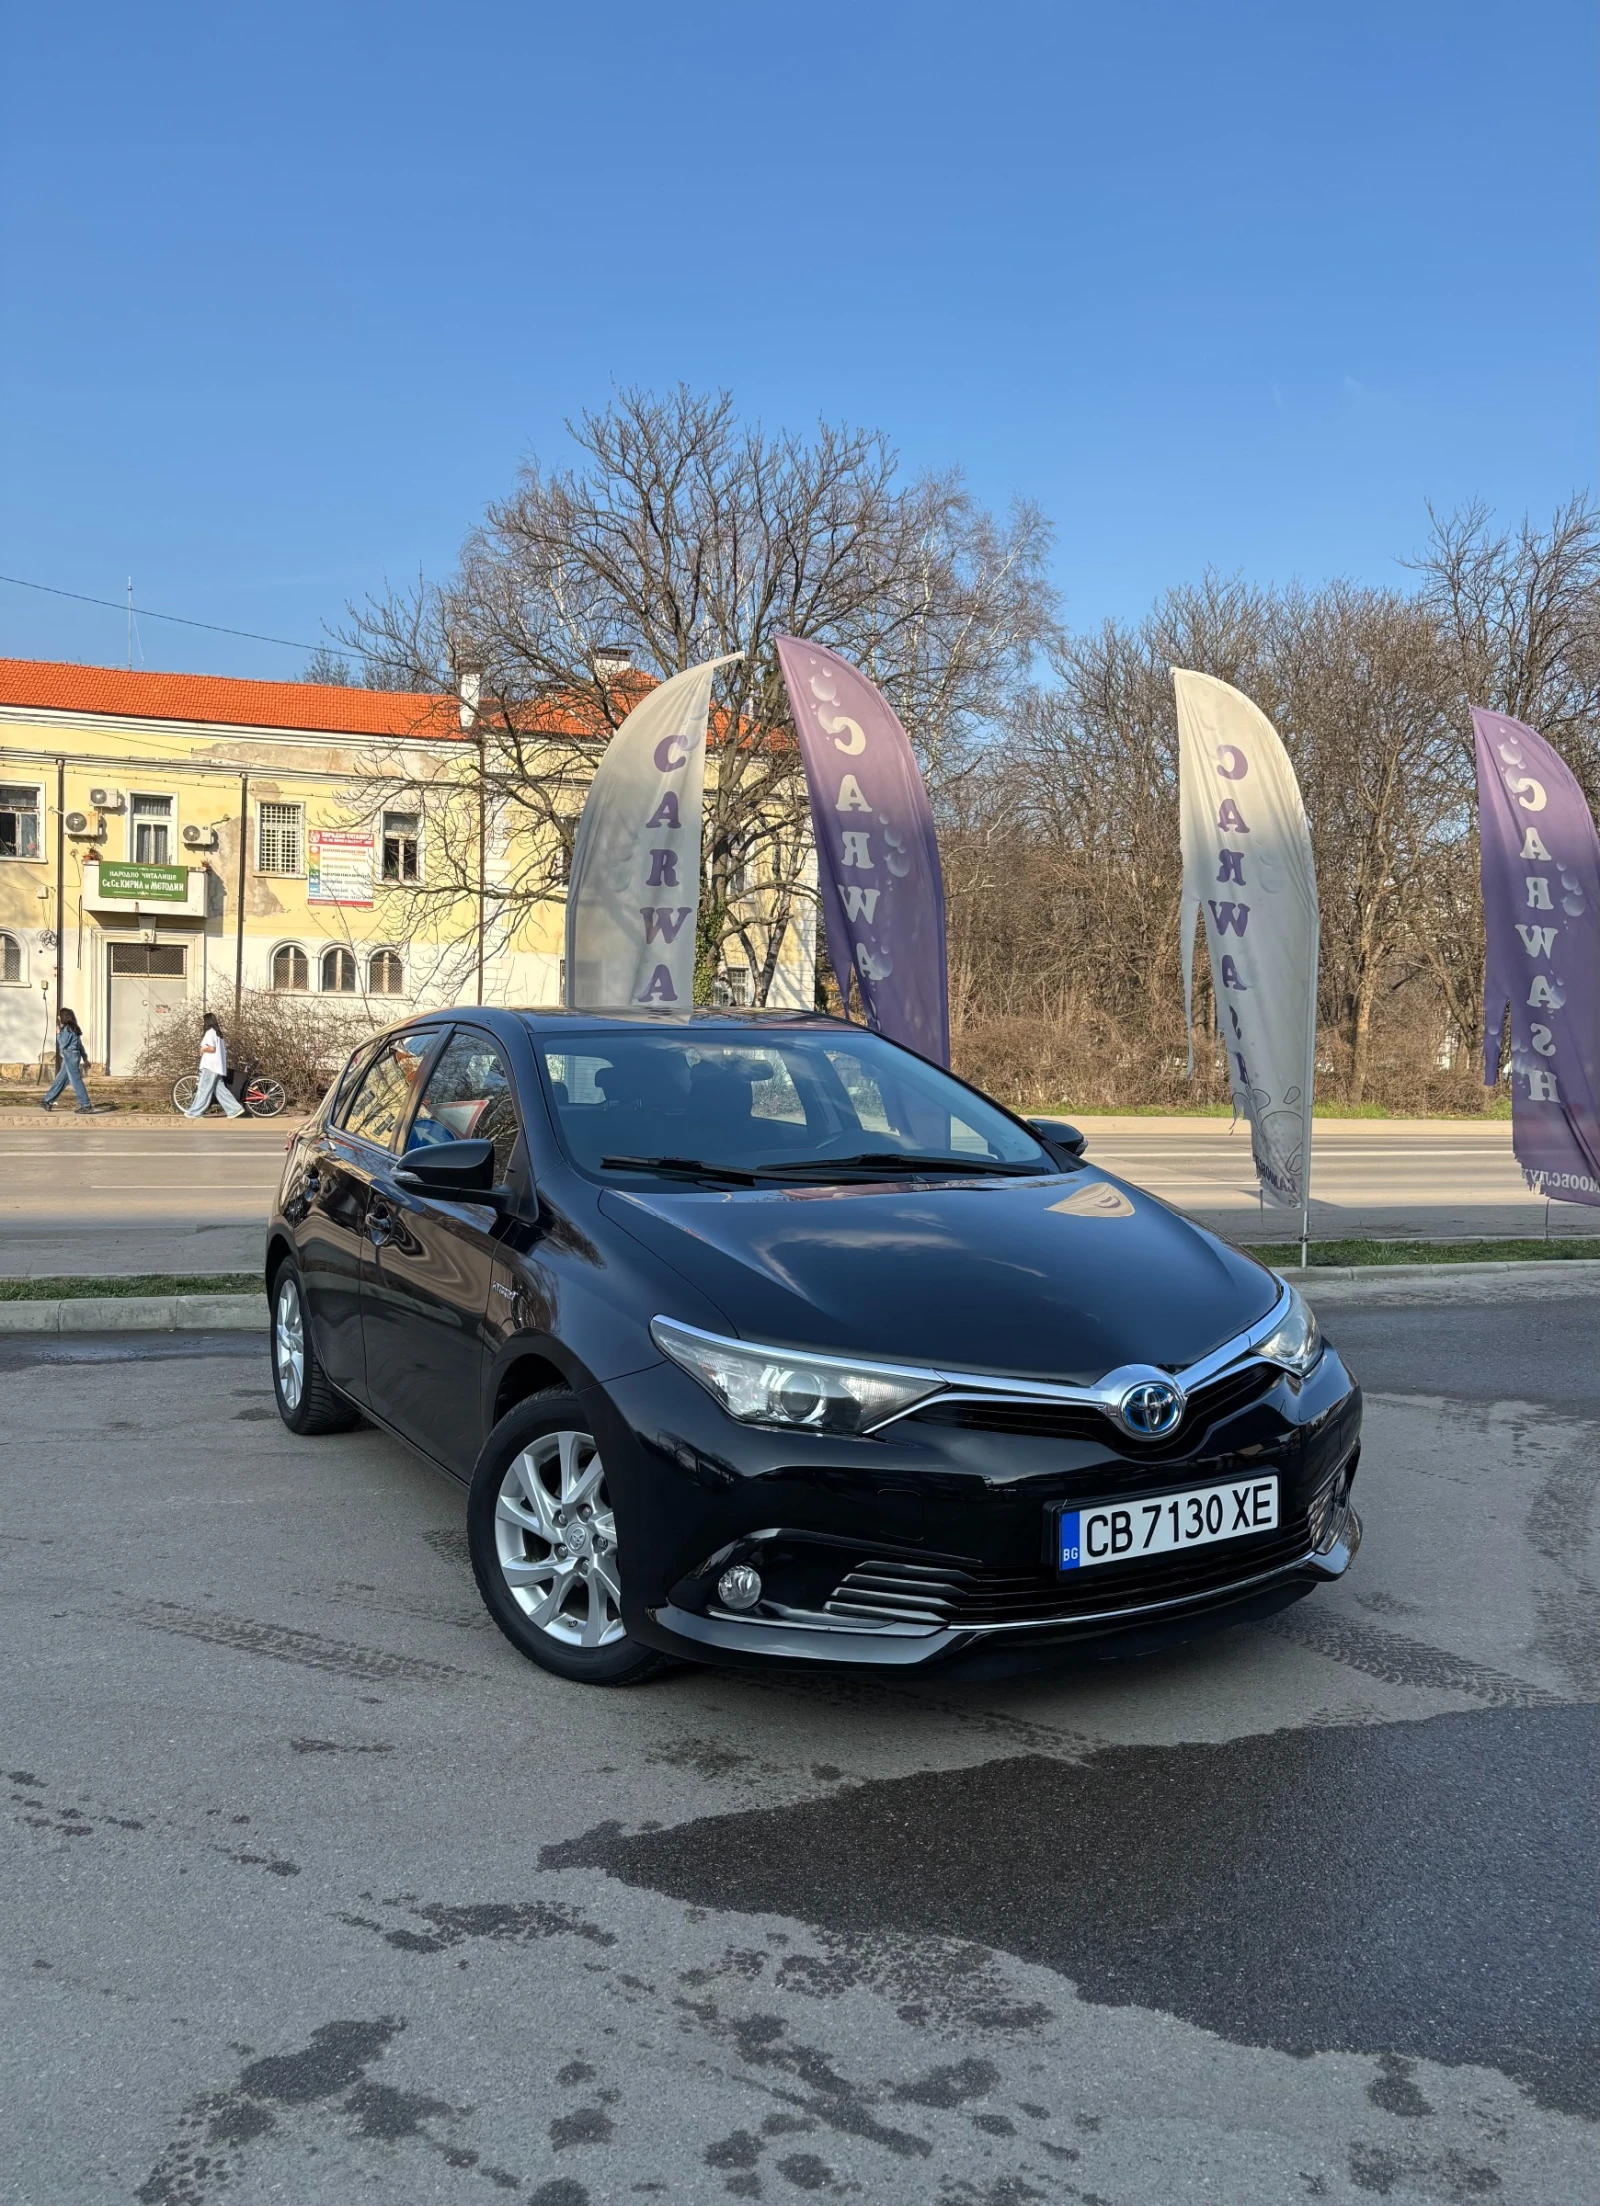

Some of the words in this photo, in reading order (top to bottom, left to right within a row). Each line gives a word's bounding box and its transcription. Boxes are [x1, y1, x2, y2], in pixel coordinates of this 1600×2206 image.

[1086, 1510, 1133, 1558] CB
[1142, 1494, 1223, 1549] 7130
[1232, 1483, 1273, 1531] XE
[1063, 1547, 1079, 1562] BG
